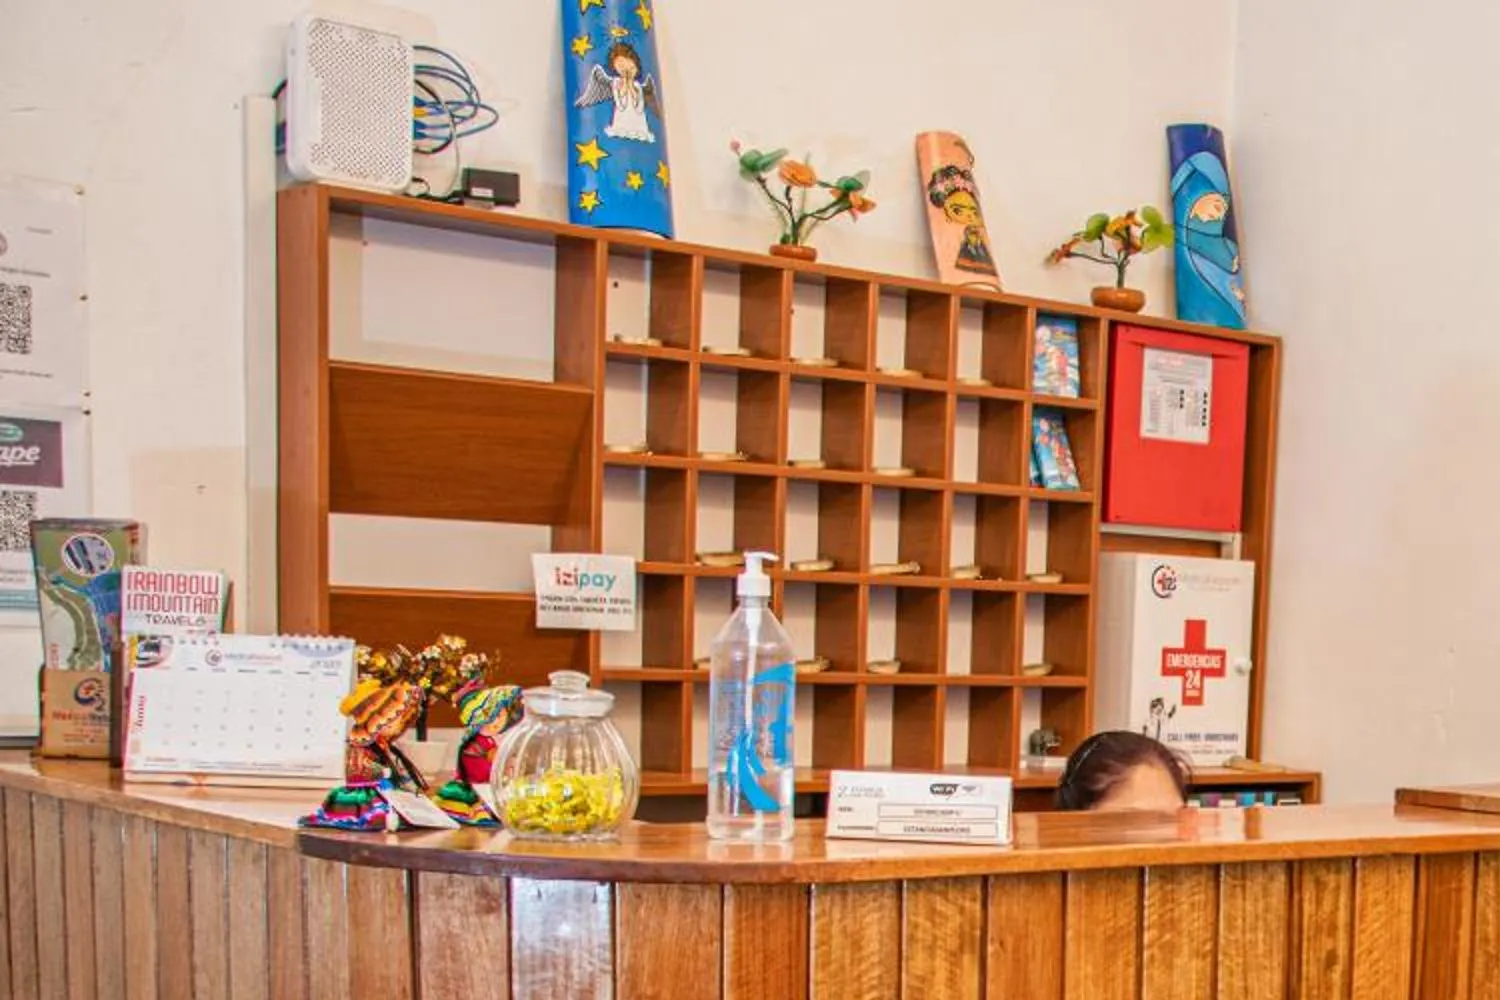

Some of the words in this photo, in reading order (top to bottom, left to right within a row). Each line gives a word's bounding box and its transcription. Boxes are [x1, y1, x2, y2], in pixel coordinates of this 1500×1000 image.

[0, 444, 41, 467] ape
[554, 566, 617, 591] izipay
[1185, 669, 1201, 690] 24
